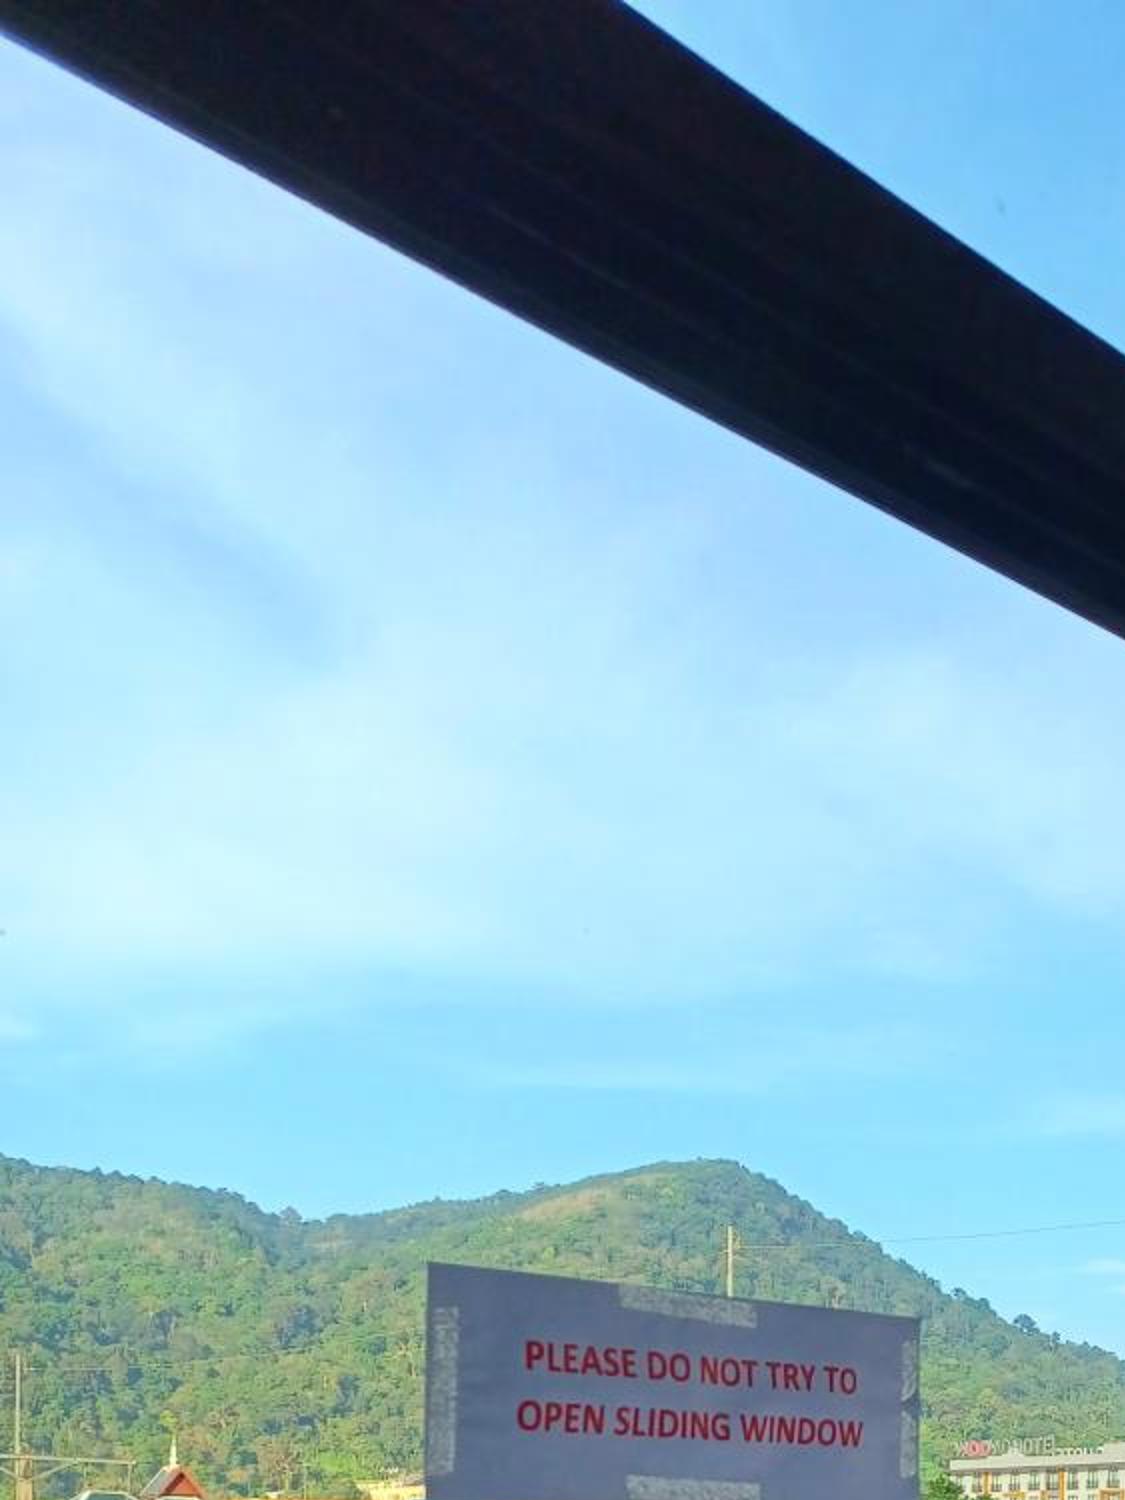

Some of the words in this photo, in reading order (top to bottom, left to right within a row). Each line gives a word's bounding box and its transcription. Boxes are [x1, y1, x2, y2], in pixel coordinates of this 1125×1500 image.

[525, 1340, 637, 1378] PLEASE
[647, 1351, 691, 1382] DO
[701, 1356, 758, 1388] NOT
[765, 1361, 815, 1391] TRY
[823, 1365, 857, 1394] TO
[517, 1400, 605, 1435] OPEN
[613, 1406, 730, 1441] SLIDING
[740, 1413, 863, 1447] WINDOW
